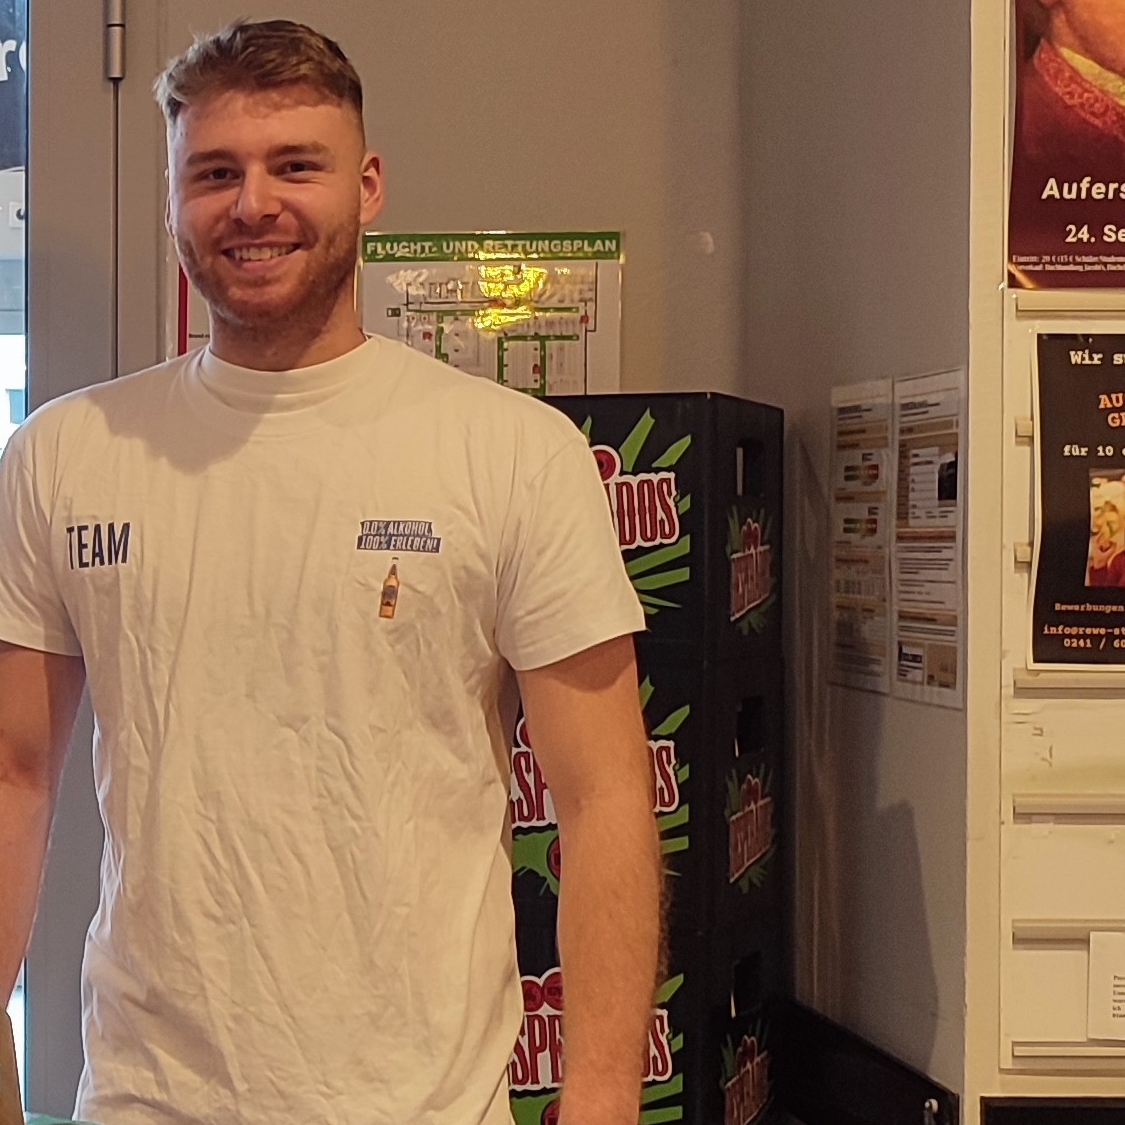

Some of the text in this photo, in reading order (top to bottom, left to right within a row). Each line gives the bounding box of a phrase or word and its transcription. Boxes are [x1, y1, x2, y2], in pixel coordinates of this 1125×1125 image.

[1064, 224, 1096, 244] 24.
[366, 239, 618, 255] FLUCHT- UND RETTUNGSPLAN
[1069, 349, 1103, 365] Wir
[1063, 444, 1114, 456] für 10
[387, 521, 432, 537] ALKOHOL,
[66, 521, 131, 570] TEAM
[360, 535, 438, 552] 100% ERLEBEN!
[1064, 638, 1092, 648] 0241
